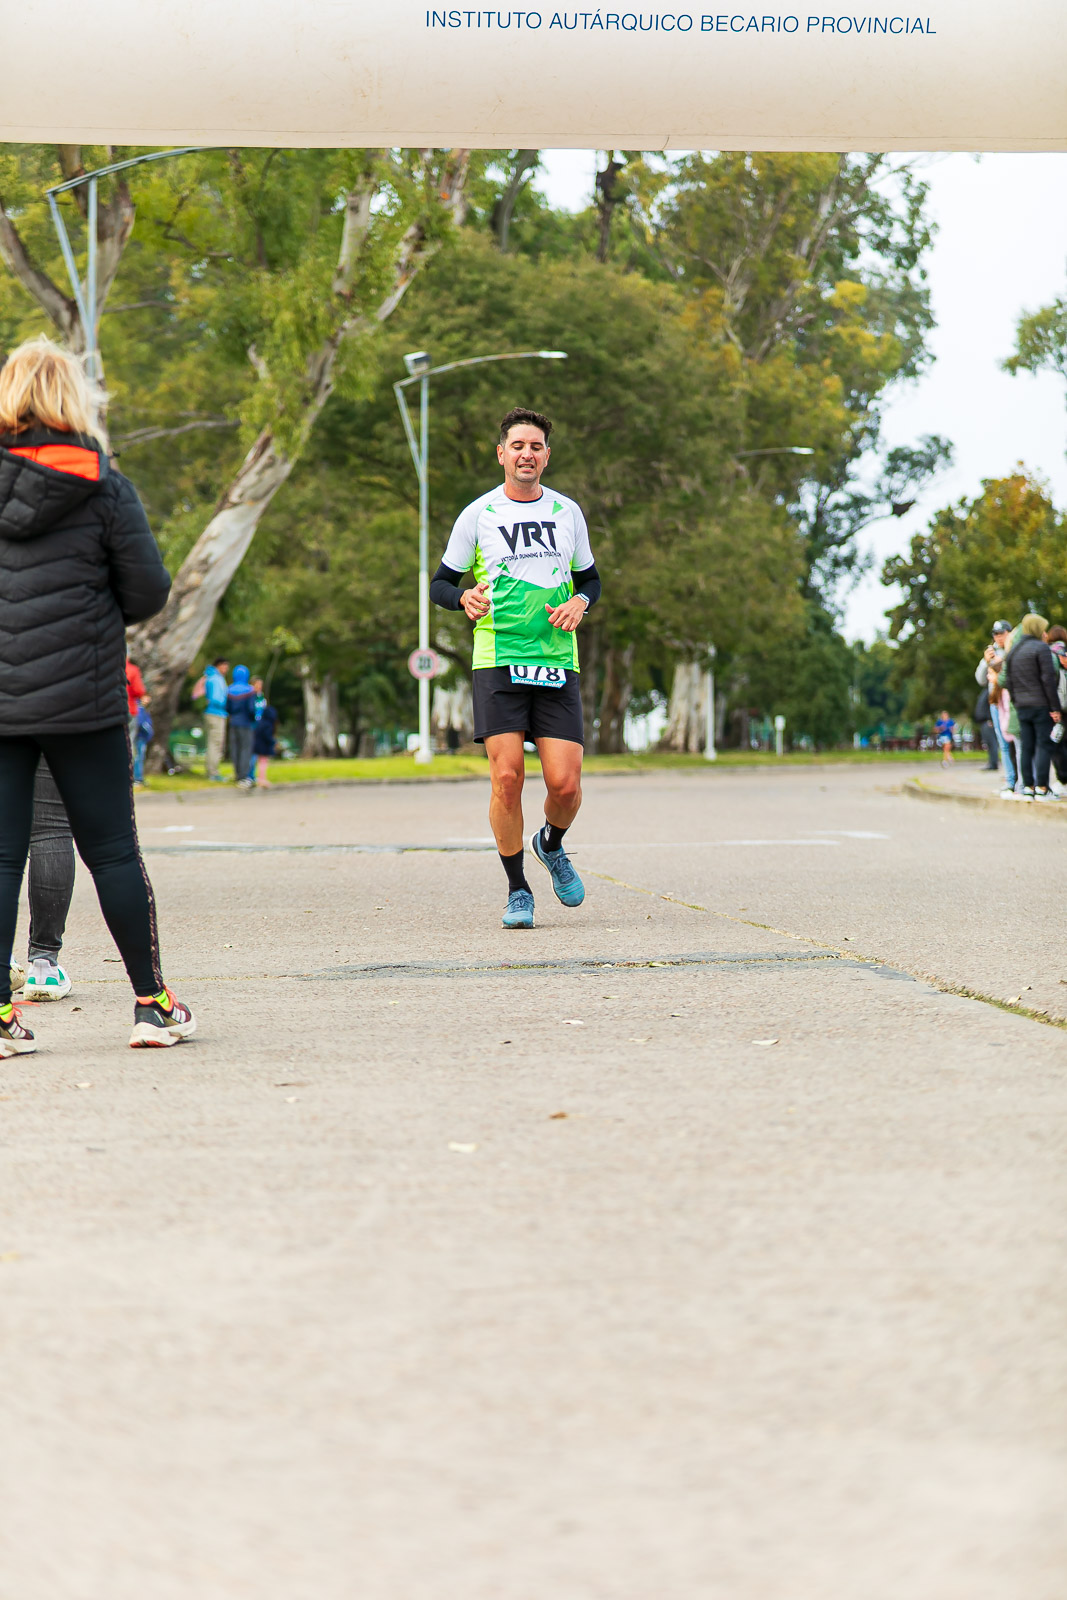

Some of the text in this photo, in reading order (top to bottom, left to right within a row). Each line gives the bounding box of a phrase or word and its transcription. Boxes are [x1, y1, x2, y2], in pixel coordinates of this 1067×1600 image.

[425, 8, 937, 34] INSTITUTO AUTÁRQUICO BECARIO PROVINCIAL
[497, 521, 557, 555] VRT
